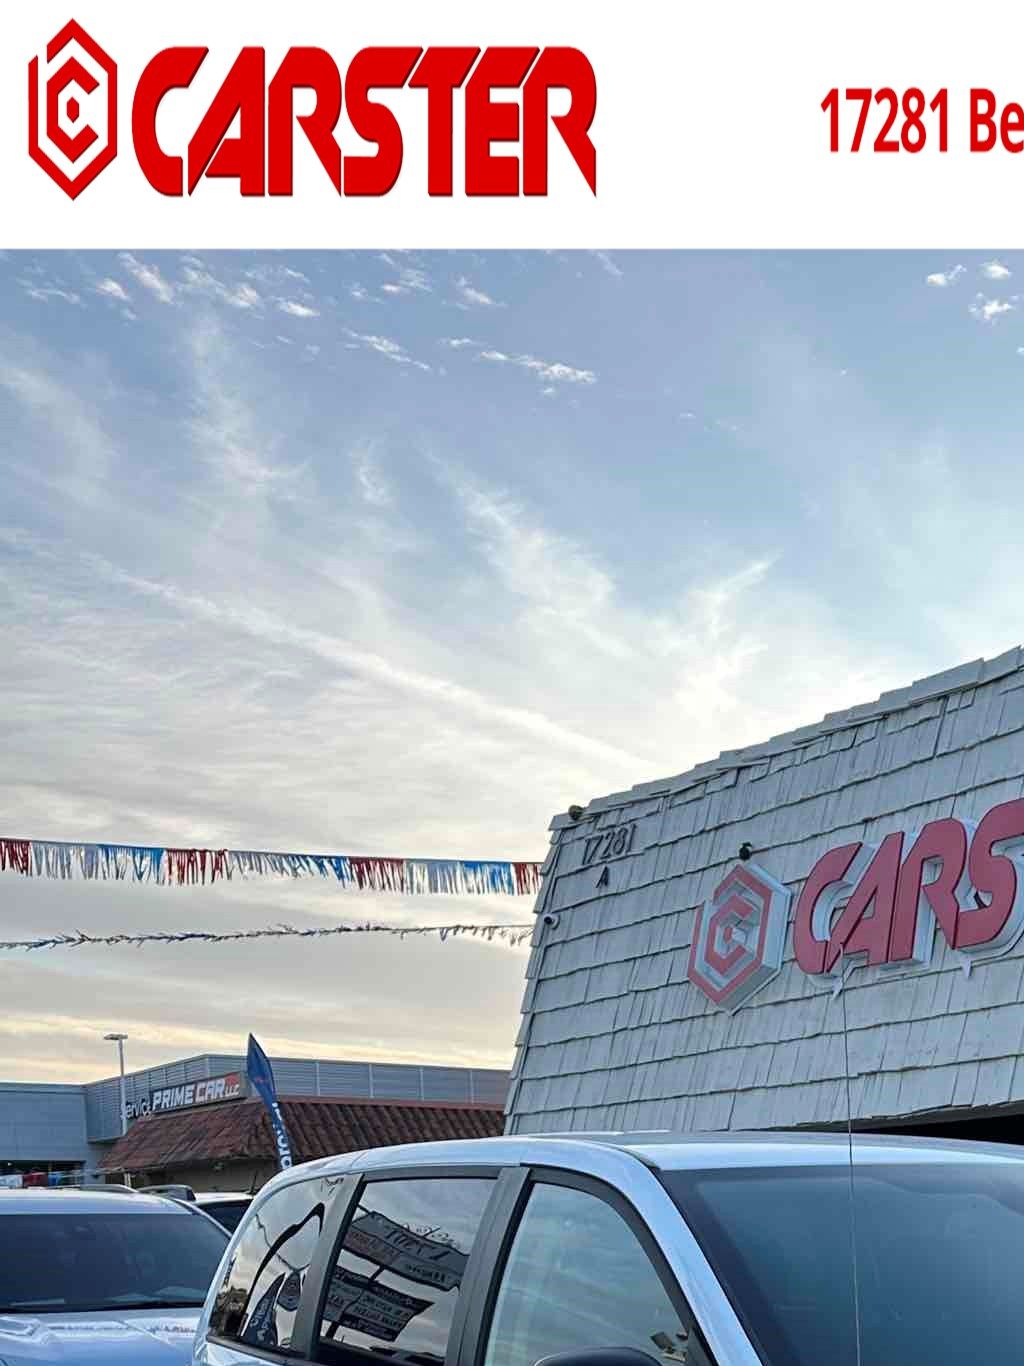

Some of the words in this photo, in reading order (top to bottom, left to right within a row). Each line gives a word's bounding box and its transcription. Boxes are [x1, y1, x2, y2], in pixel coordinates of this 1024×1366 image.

[581, 823, 637, 866] 17281
[152, 1083, 195, 1111] PRIME
[195, 1078, 226, 1103] CAR
